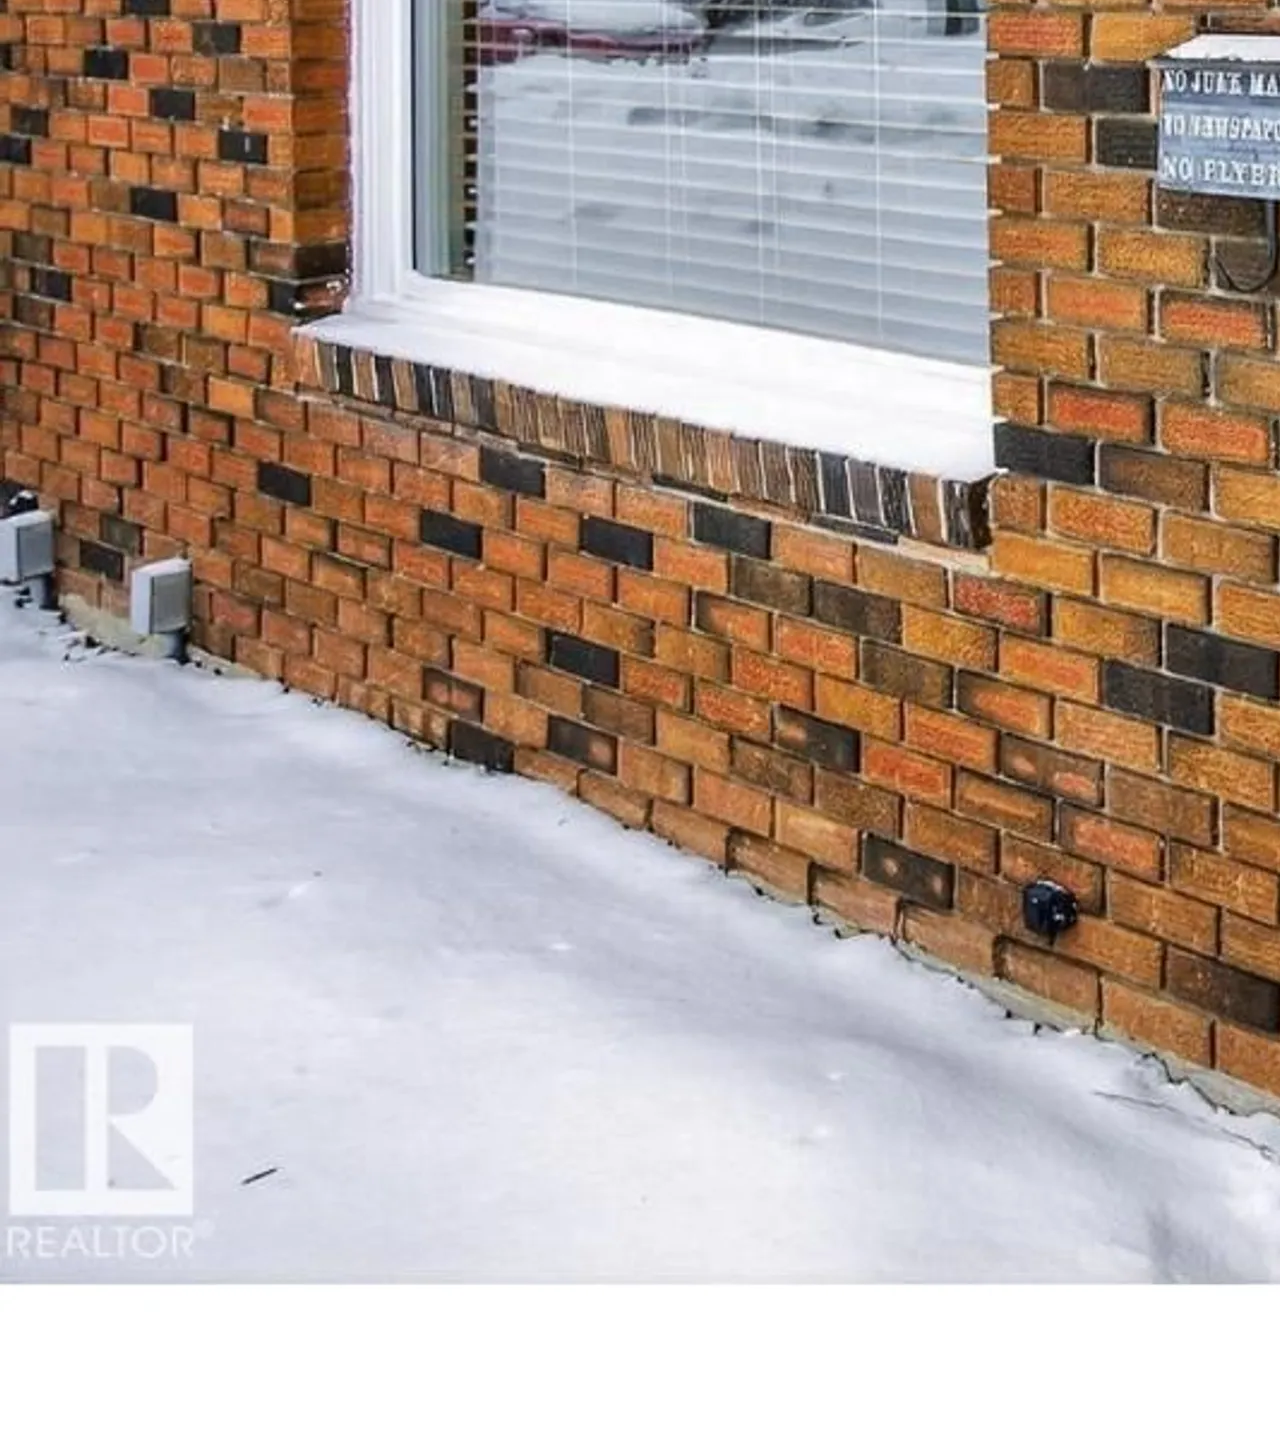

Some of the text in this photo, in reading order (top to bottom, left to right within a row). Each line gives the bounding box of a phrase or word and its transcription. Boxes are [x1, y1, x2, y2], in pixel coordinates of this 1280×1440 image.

[1162, 69, 1188, 93] NO
[1191, 70, 1243, 96] JUNK
[1162, 155, 1194, 181] NO
